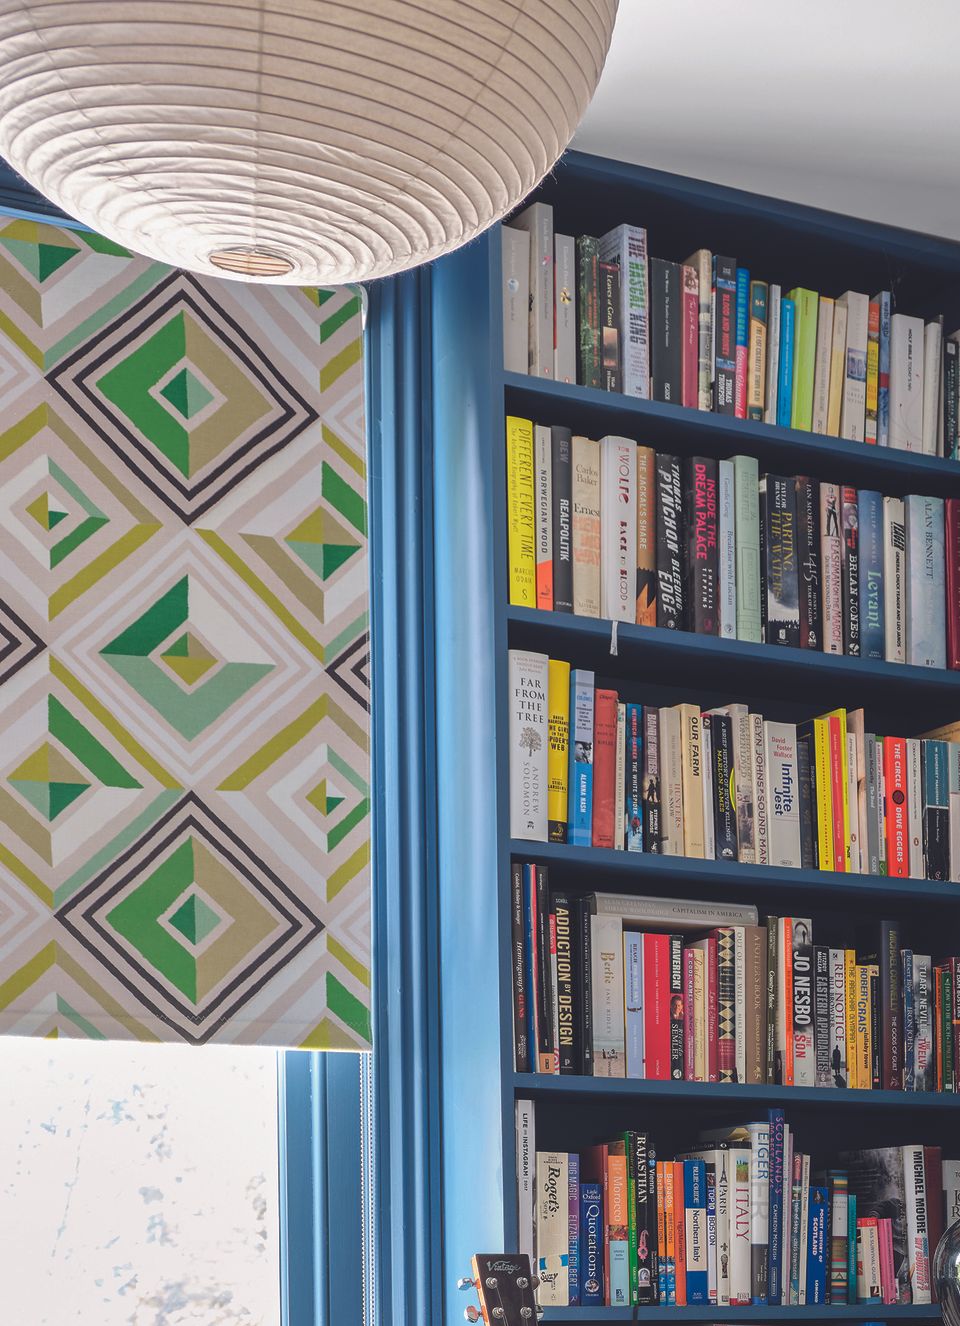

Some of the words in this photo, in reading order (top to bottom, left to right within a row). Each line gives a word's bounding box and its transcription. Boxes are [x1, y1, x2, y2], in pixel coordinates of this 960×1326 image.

[629, 236, 646, 258] THE
[606, 274, 614, 298] Leaves
[629, 261, 646, 310] RASCAL
[605, 306, 615, 327] Grass
[629, 313, 647, 344] KING
[519, 428, 532, 487] DIFFERENT
[560, 440, 568, 462] BEW
[671, 463, 682, 513] THOMAS
[695, 463, 706, 508] DREAM
[707, 479, 716, 517] INSIDE
[520, 493, 533, 528] EVERY
[658, 469, 679, 554] PYNCHON
[924, 500, 933, 529] ALAN
[520, 533, 534, 561] TIME
[560, 498, 570, 561] REALPOLITIK
[695, 511, 707, 560] PALACE
[707, 523, 716, 548] THE
[726, 531, 734, 562] Breakfast
[782, 511, 793, 571] PARTING
[924, 531, 934, 580] BENNETT
[672, 560, 683, 612] BLEEDING
[849, 553, 858, 596] BRIAN
[658, 570, 676, 615] EDGE
[727, 581, 735, 606] Lucian
[866, 570, 882, 630] Levant
[850, 600, 859, 640] JONES
[515, 689, 546, 701] FROM
[520, 677, 542, 689] FAR
[517, 711, 545, 724] TREE
[519, 700, 542, 712] THE
[754, 716, 762, 746] GLYN
[692, 744, 700, 777] FARM
[756, 750, 764, 787] JOHNS
[774, 787, 784, 817] Jest
[781, 763, 793, 813] Infinite
[757, 795, 765, 834] SOUND
[759, 838, 767, 864] MAN
[896, 831, 904, 863] EGGERS
[672, 906, 707, 917] CAPITALISM
[717, 911, 743, 919] AMERICA
[556, 907, 571, 982] ADDICTION
[794, 951, 810, 971] JO
[889, 930, 898, 968] MICHAEL
[516, 941, 525, 994] Hemingway's
[672, 940, 681, 990] MAVERICK!
[834, 963, 844, 988] RED
[919, 960, 928, 995] STUART
[565, 983, 571, 993] BY
[816, 976, 828, 1015] EASTERN
[860, 967, 868, 1001] ROBERT
[889, 970, 898, 1013] CONNELLY
[559, 995, 573, 1046] DESIGN
[835, 992, 845, 1042] NOTICE
[857, 1001, 867, 1033] CRAIS
[919, 998, 928, 1035] NEVILLE
[795, 1034, 807, 1059] SON
[817, 1018, 829, 1071] APPROACHES
[892, 1045, 897, 1054] OF
[918, 1037, 926, 1070] TWELVE
[568, 1161, 577, 1175] BIG
[636, 1136, 648, 1204] RAJASTHAN
[757, 1132, 769, 1180] EIGER
[775, 1116, 784, 1194] SCOTLAND'S
[544, 1166, 562, 1213] Roget's
[568, 1176, 578, 1201] MAGIC
[648, 1168, 656, 1194] Vienna
[666, 1173, 674, 1208] Barbados
[692, 1166, 700, 1182] BLUE
[913, 1151, 923, 1195] MICHAEL
[612, 1175, 623, 1222] Morocco
[718, 1183, 728, 1215] PARIS
[735, 1187, 750, 1242] ITALY
[915, 1198, 926, 1234] MOORE
[568, 1214, 578, 1254] ELIZABETH
[586, 1204, 601, 1277] Quotations
[692, 1209, 701, 1245] Northern
[709, 1216, 717, 1246] BOSTON
[486, 1260, 521, 1275] Vintage
[692, 1246, 702, 1262] Italy
[818, 1255, 824, 1263] OF
[569, 1256, 578, 1288] GILBERT
